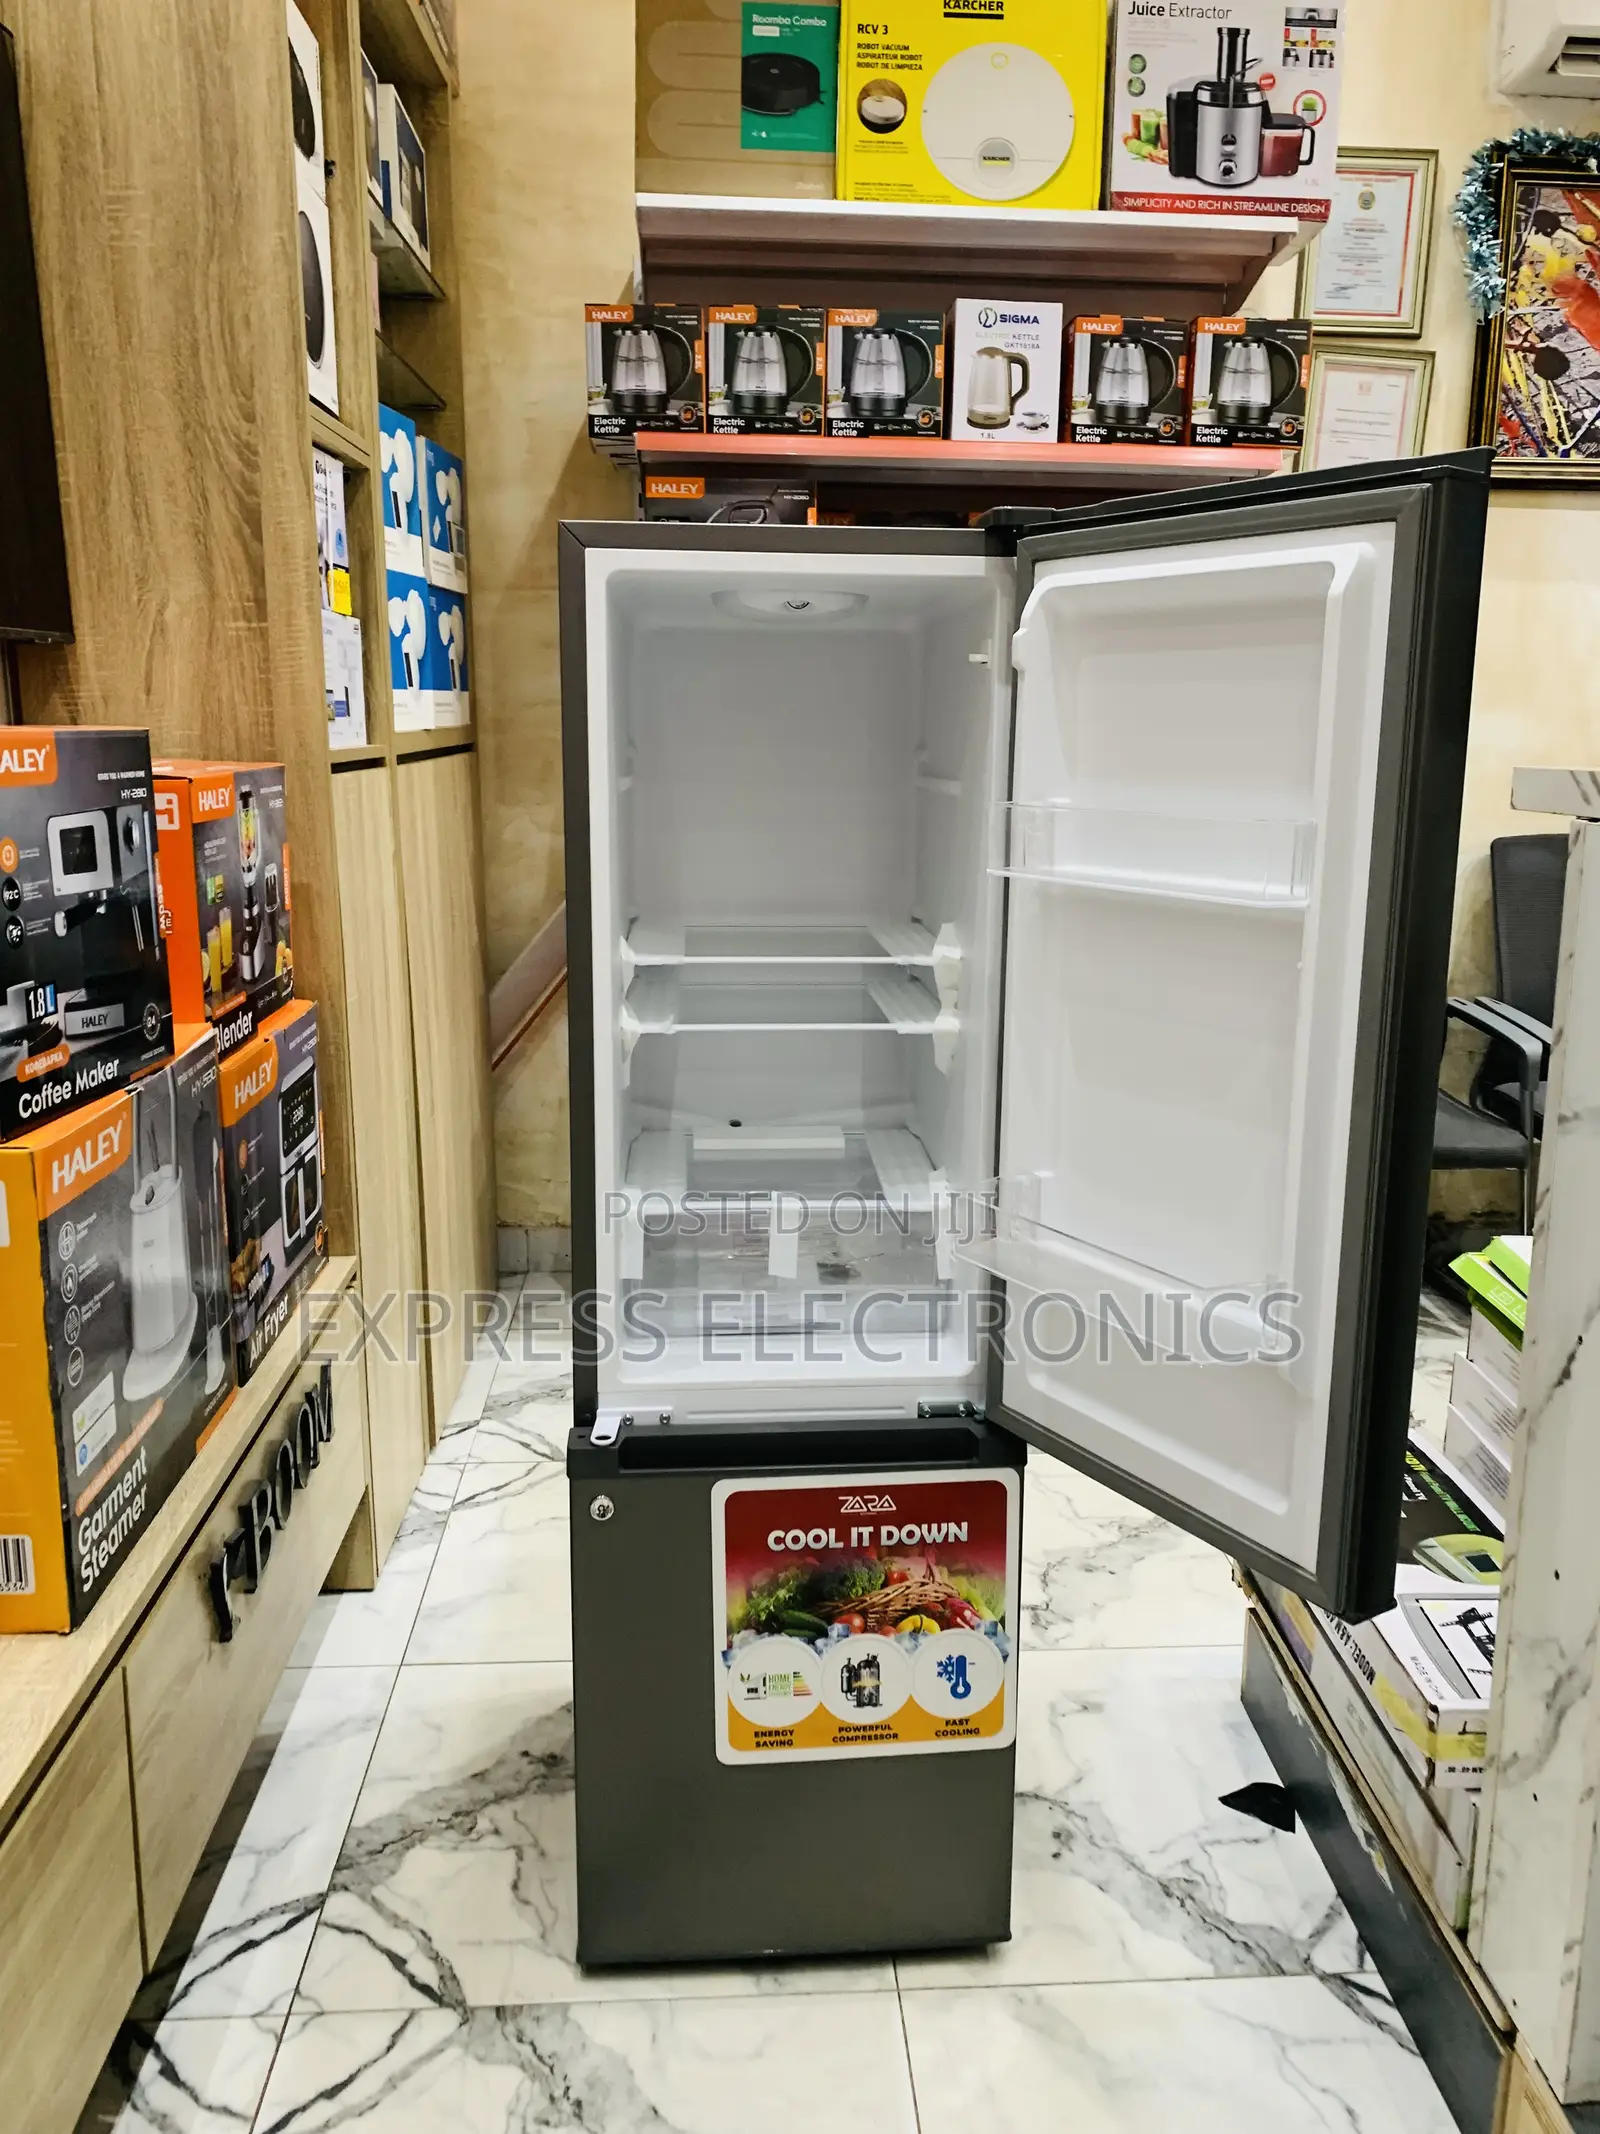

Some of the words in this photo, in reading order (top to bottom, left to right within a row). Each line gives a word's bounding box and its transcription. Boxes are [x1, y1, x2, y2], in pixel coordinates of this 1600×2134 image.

[1128, 1, 1165, 16] Juice
[1169, 2, 1232, 19] Extractor
[793, 16, 827, 27] Combo
[857, 23, 879, 35] RCV
[882, 25, 888, 35] 3
[857, 52, 898, 61] ASPIRATEUR
[891, 63, 923, 71] LIMPIEZA
[1123, 196, 1172, 209] SIMPLICITY
[1174, 199, 1196, 209] AND
[1198, 200, 1220, 210] RICH
[1222, 200, 1232, 210] IN
[1233, 201, 1289, 213] STREAMLINE
[1291, 203, 1325, 214] DESIGN
[592, 310, 628, 320] HALEY
[715, 312, 751, 321] HALEY
[835, 314, 871, 323] HALEY
[999, 313, 1040, 325] SIGMA
[1082, 322, 1118, 332] HALEY
[1204, 322, 1241, 332] HALEY
[1012, 333, 1040, 341] KETTLE
[594, 417, 626, 426] Electric
[713, 418, 745, 426] Electric
[832, 420, 864, 429] Electric
[594, 425, 620, 434] Kettle
[713, 426, 739, 434] Kettle
[832, 428, 858, 437] Kettle
[1076, 425, 1107, 435] Electric
[1196, 426, 1229, 435] Electric
[1075, 434, 1101, 443] Kettle
[1196, 434, 1221, 443] Kettle
[651, 482, 699, 495] HALEY
[0, 748, 45, 773] ALEY
[198, 787, 231, 812] HALEY
[82, 1014, 108, 1029] HALEY
[18, 1080, 72, 1118] Coffee
[75, 1058, 120, 1094] Maker
[234, 1058, 272, 1109] HALEY
[52, 1120, 123, 1194] HALEY
[250, 1329, 263, 1368] Air
[264, 1293, 289, 1341] Fryer
[78, 1446, 147, 1556] Garment
[838, 1494, 896, 1513] ZARA
[80, 1483, 147, 1593] Steamer
[767, 1527, 844, 1552] COOL
[850, 1525, 874, 1548] IT
[880, 1521, 968, 1547] DOWN
[945, 1718, 970, 1727] FAST
[753, 1729, 795, 1739] ENERGY
[838, 1724, 893, 1734] POWERFUL
[934, 1728, 981, 1738] COOLING
[832, 1733, 900, 1743] COMPRESSOR
[754, 1739, 794, 1748] SAVING
